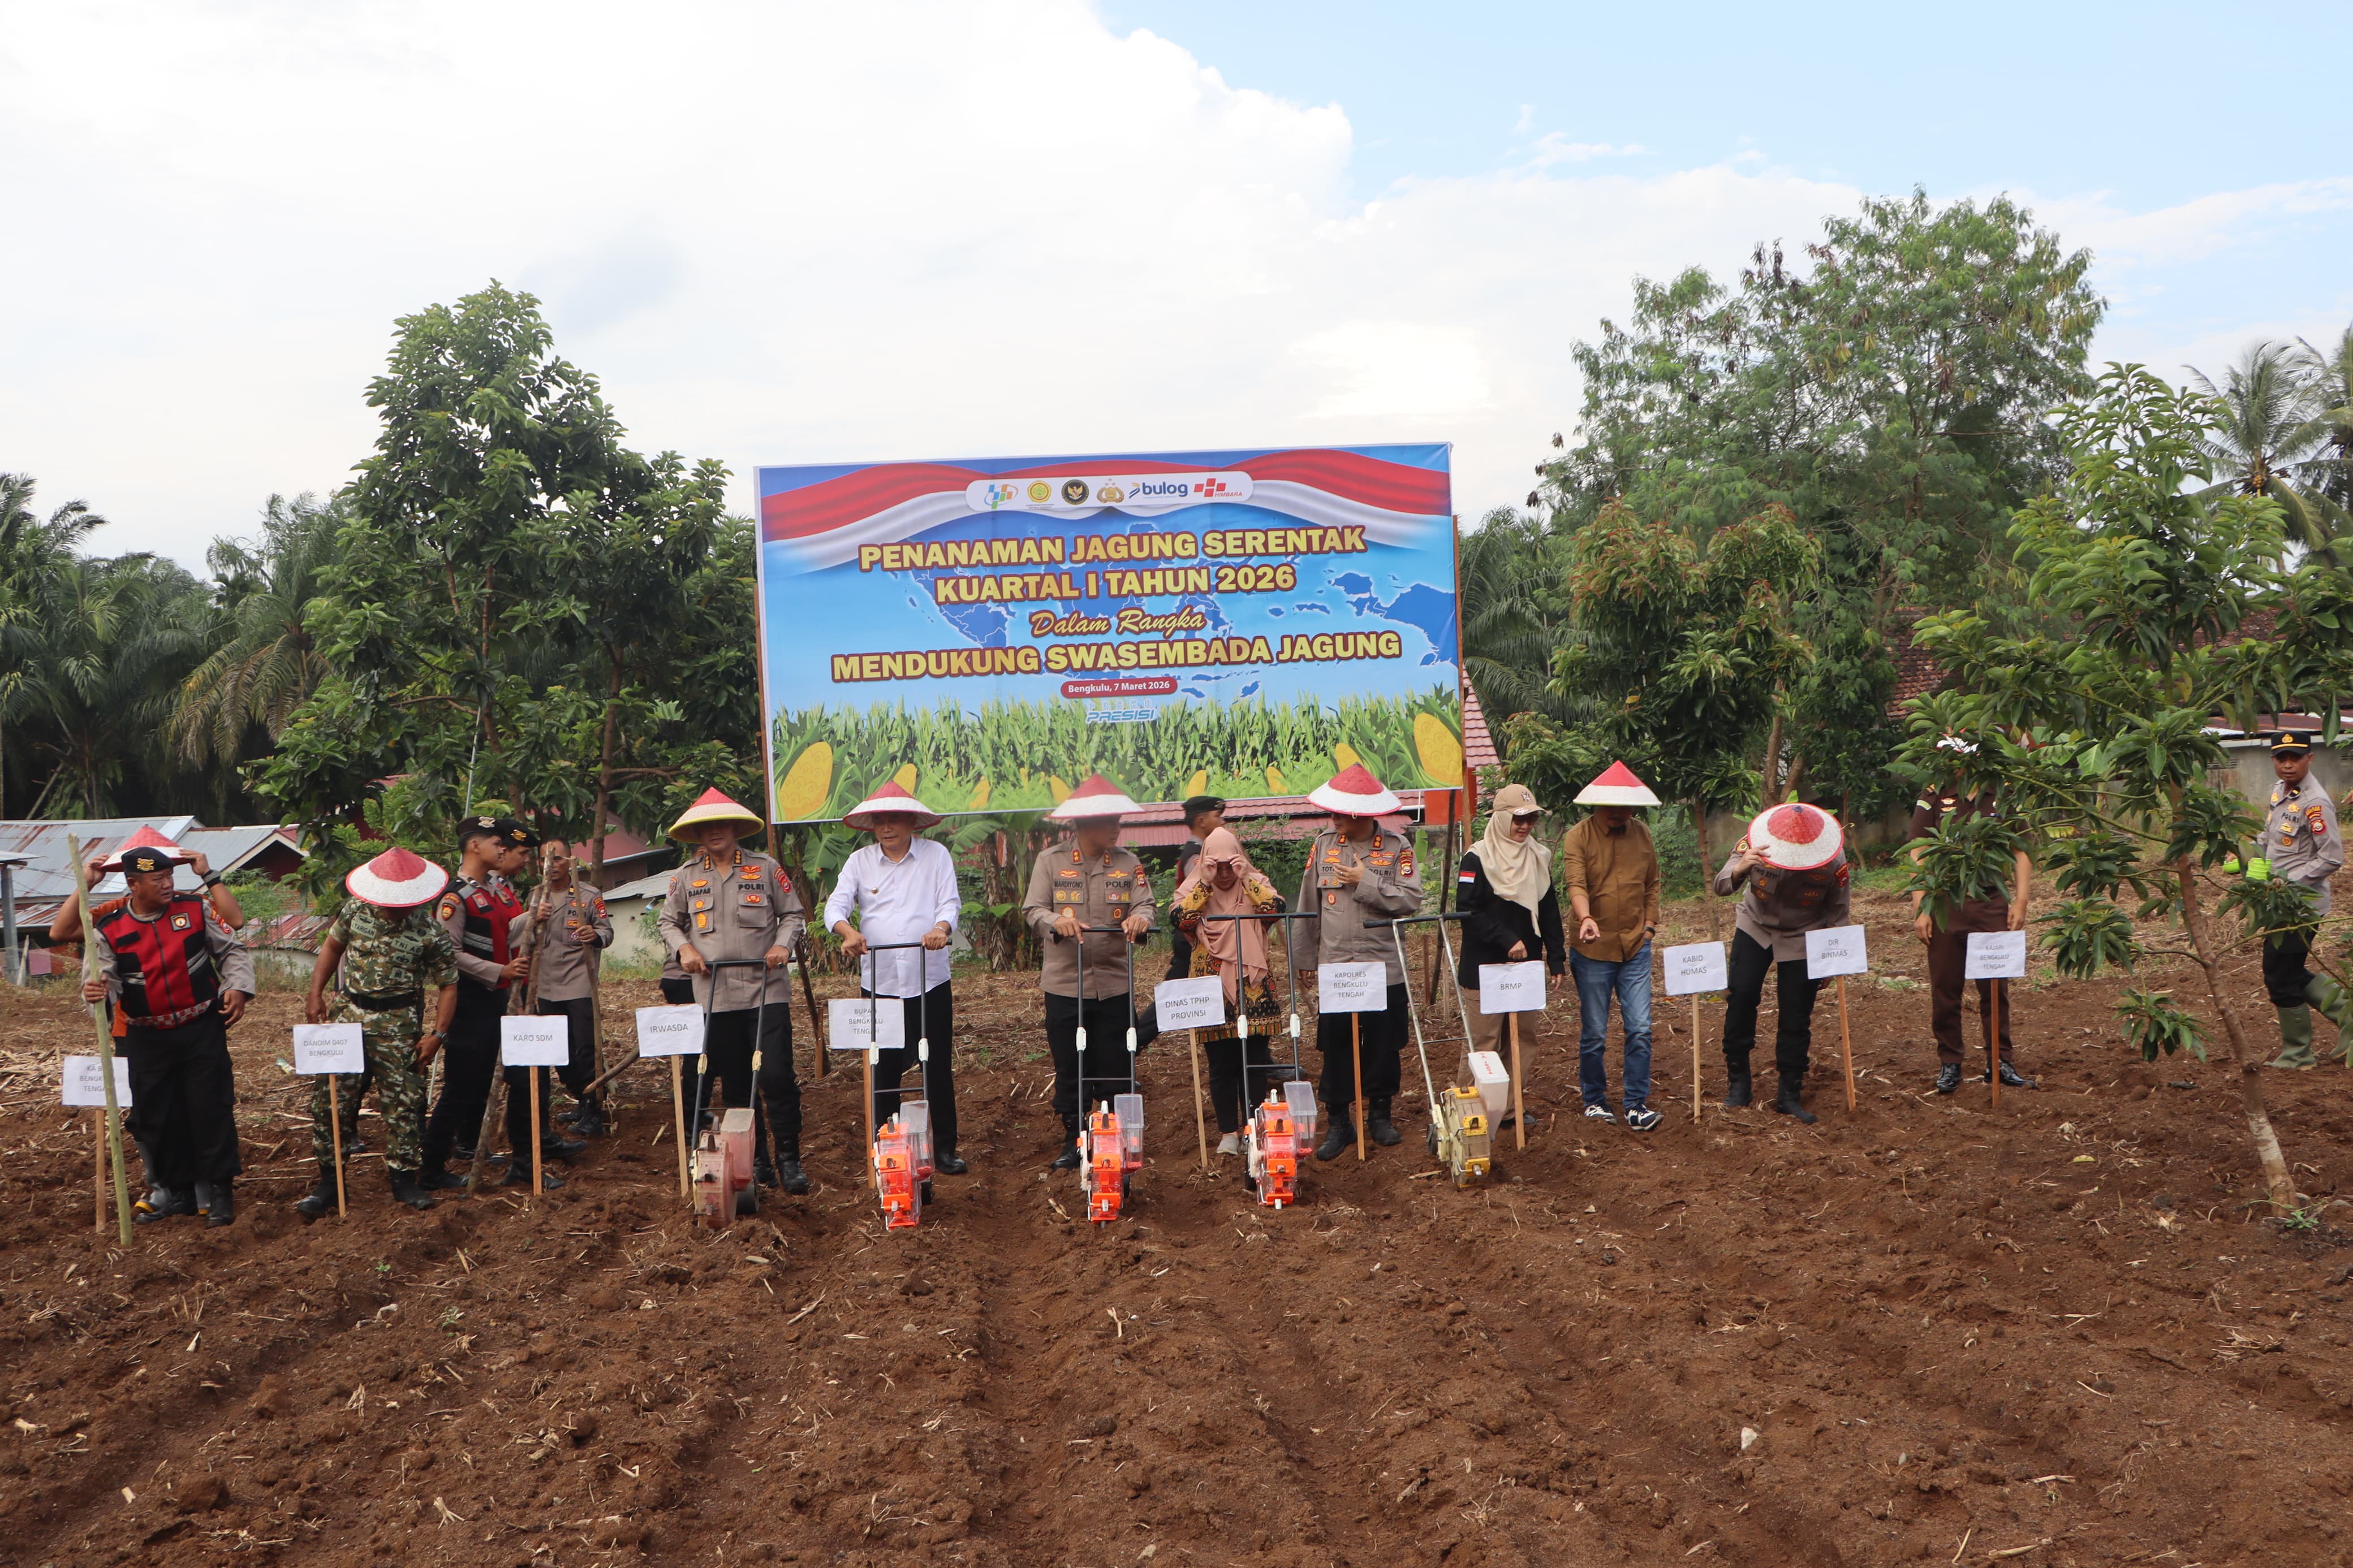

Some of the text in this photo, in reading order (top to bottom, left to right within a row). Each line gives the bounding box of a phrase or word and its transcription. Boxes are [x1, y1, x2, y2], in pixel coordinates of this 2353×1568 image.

[1142, 482, 1188, 497] bulog
[860, 526, 1367, 571] PENANAMAN JAGUNG SERENTAK
[936, 565, 1295, 603] KUARTAL I TAHUN 2026
[1031, 607, 1205, 638] Dalam Rangka
[832, 632, 1400, 680] MENDUKUNG SWASEMBADA JAGUNG
[1068, 683, 1112, 694] Bengkulu,
[1121, 682, 1146, 690] Maret
[1147, 680, 1170, 689] 2026
[1087, 709, 1154, 722] PRESISI
[688, 887, 711, 897] DJAFAR
[1683, 954, 1704, 964] KABID
[1821, 950, 1848, 959] BINMAS
[1680, 967, 1707, 976] HUMAS
[1165, 996, 1209, 1008] DINAS TPHP
[1171, 1009, 1206, 1020] PROVINSI
[650, 1023, 688, 1034] IRWASDA
